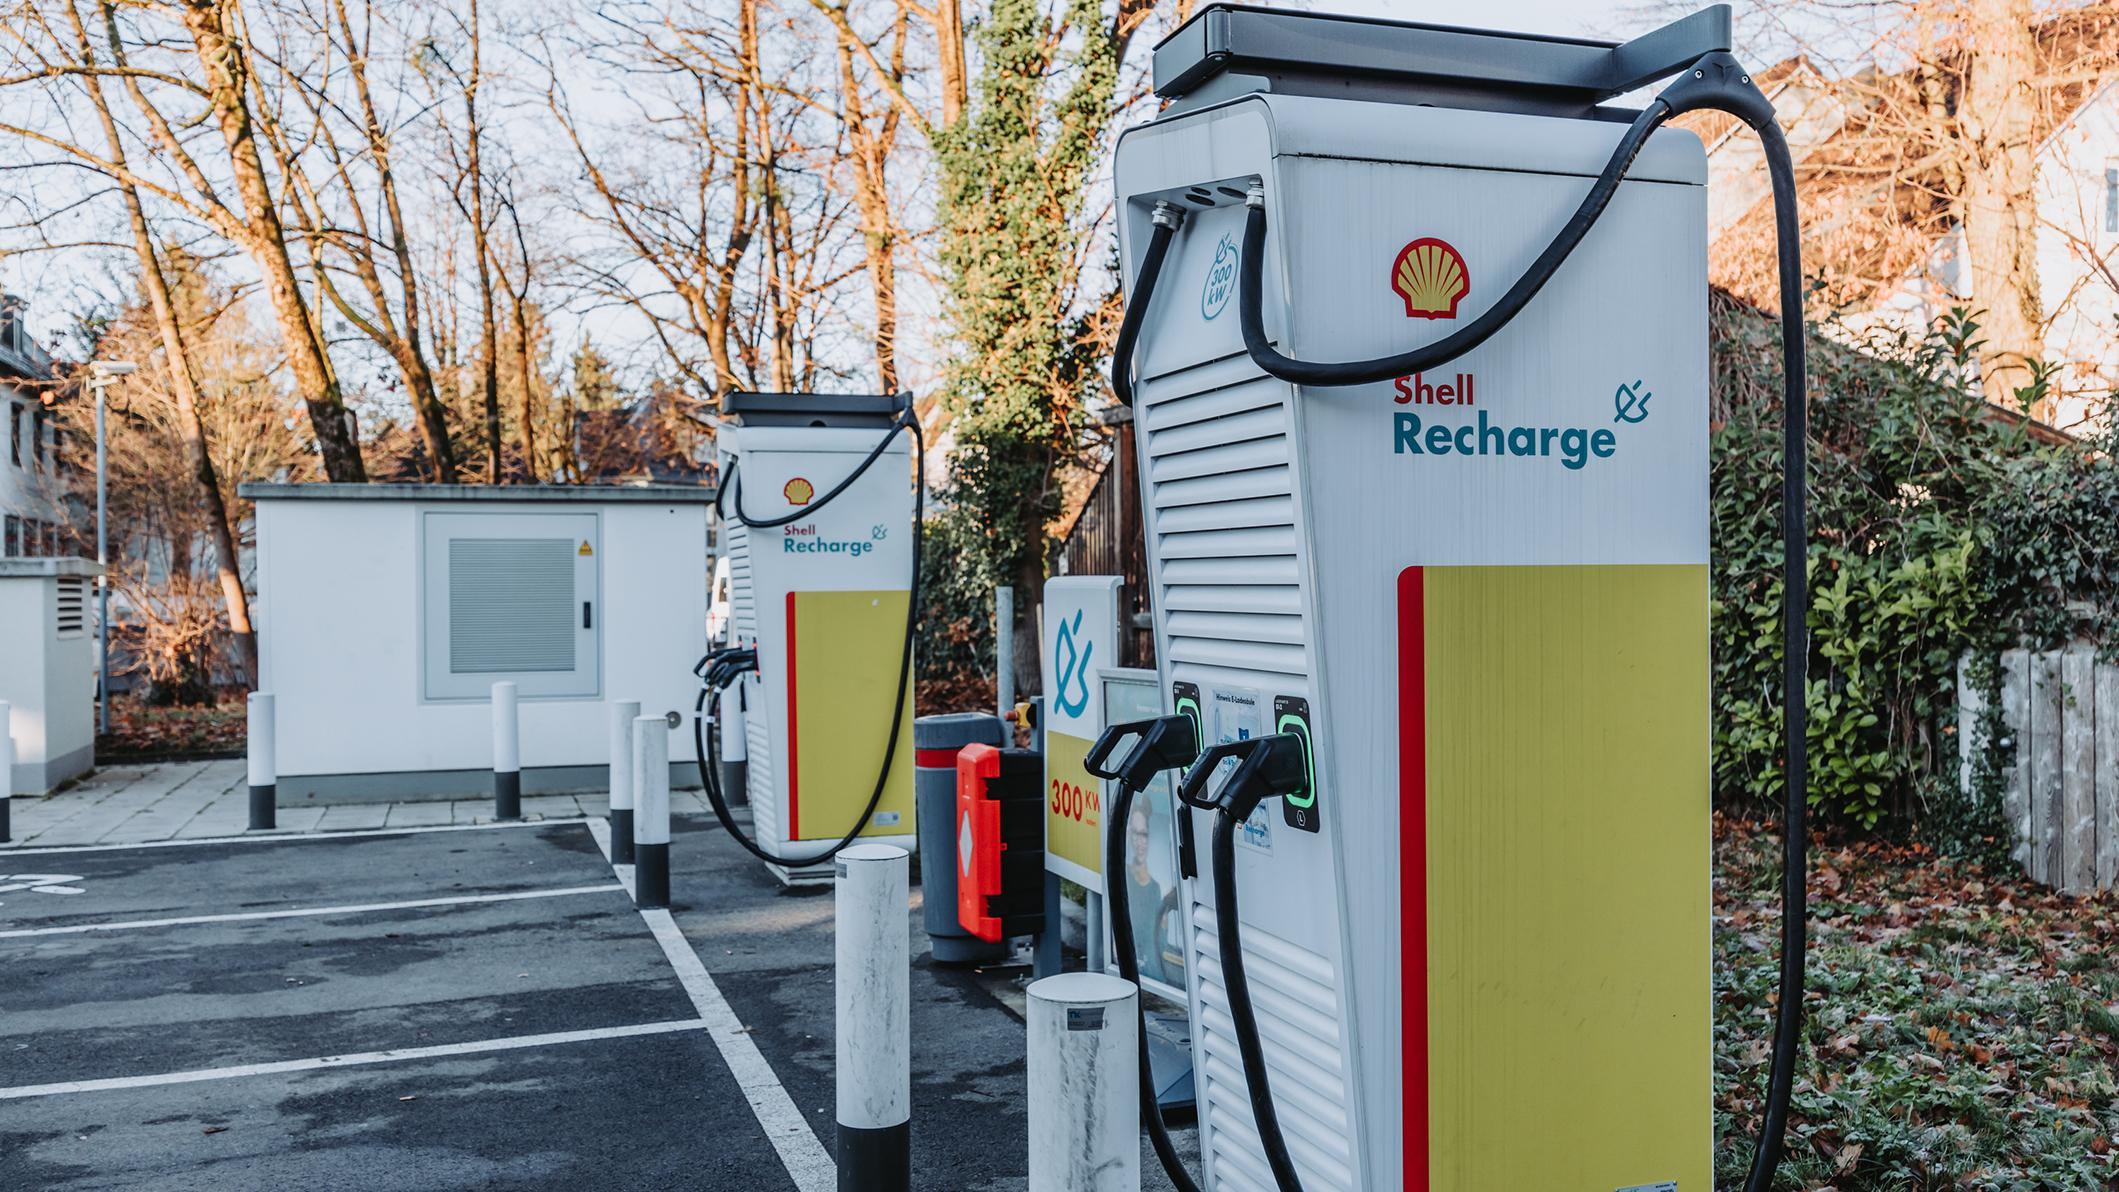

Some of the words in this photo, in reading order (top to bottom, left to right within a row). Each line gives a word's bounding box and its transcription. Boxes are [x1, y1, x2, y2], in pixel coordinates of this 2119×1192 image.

[1211, 263, 1232, 287] 300
[1394, 371, 1474, 405] Shell
[1393, 410, 1616, 470] Recharge
[784, 524, 816, 536] Shell
[784, 537, 873, 557] Recharge
[1052, 778, 1083, 822] 300
